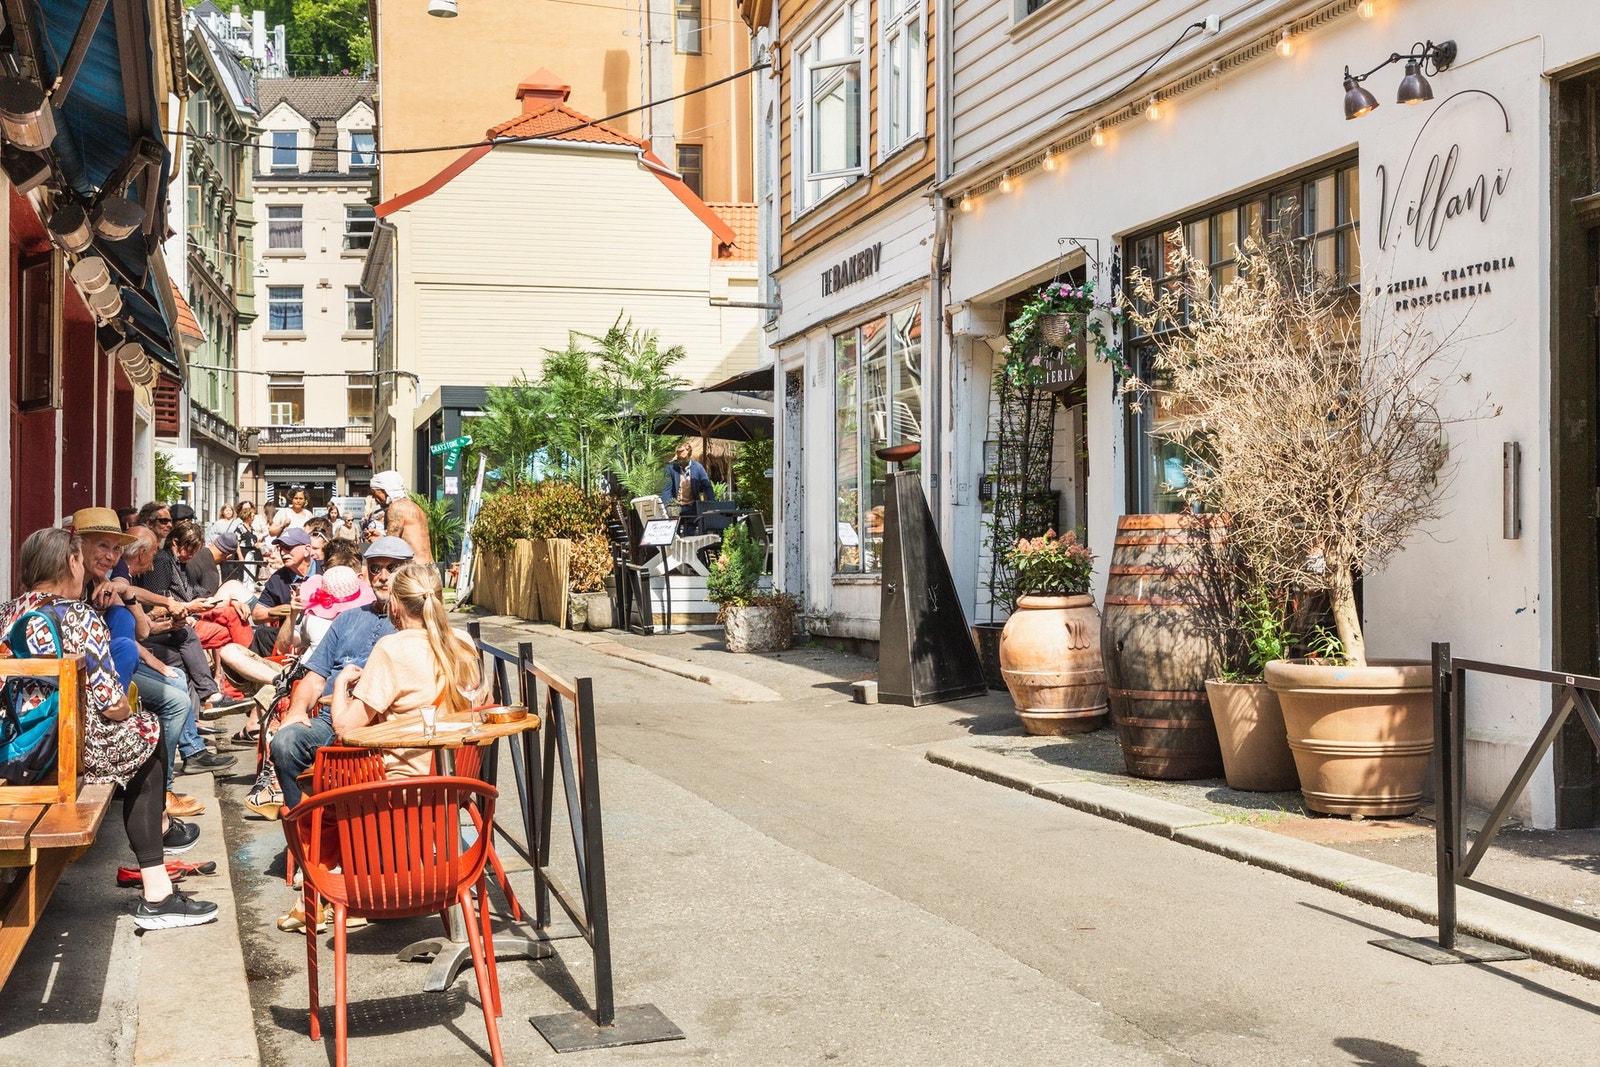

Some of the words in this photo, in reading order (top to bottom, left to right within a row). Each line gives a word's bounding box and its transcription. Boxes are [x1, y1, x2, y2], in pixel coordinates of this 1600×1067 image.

[1376, 90, 1512, 252] Villani
[821, 268, 833, 298] THE
[833, 241, 882, 293] BAKERY
[1375, 276, 1429, 297] PZZERIA
[1442, 256, 1516, 282] TRATTORIA
[1396, 281, 1492, 312] PROSECCHERIA
